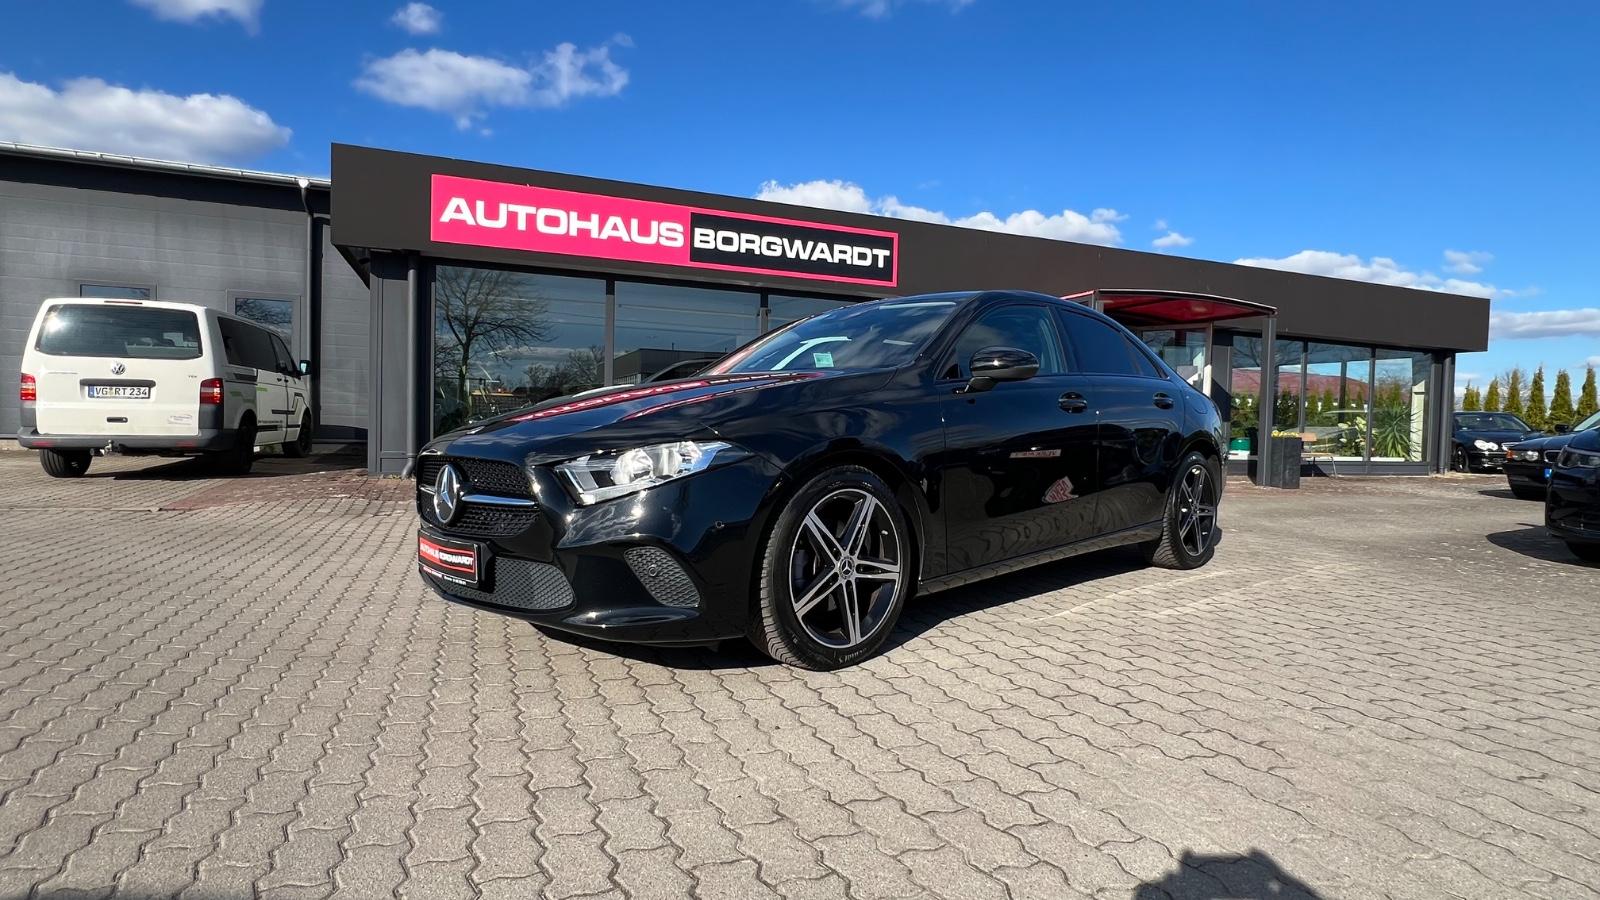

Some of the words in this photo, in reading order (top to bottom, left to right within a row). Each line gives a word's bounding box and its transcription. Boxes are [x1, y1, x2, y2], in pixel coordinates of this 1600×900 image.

[439, 196, 684, 247] AUTOHAUS
[693, 227, 890, 268] BORGWARDT
[95, 387, 108, 395] VG
[129, 387, 147, 396] 234
